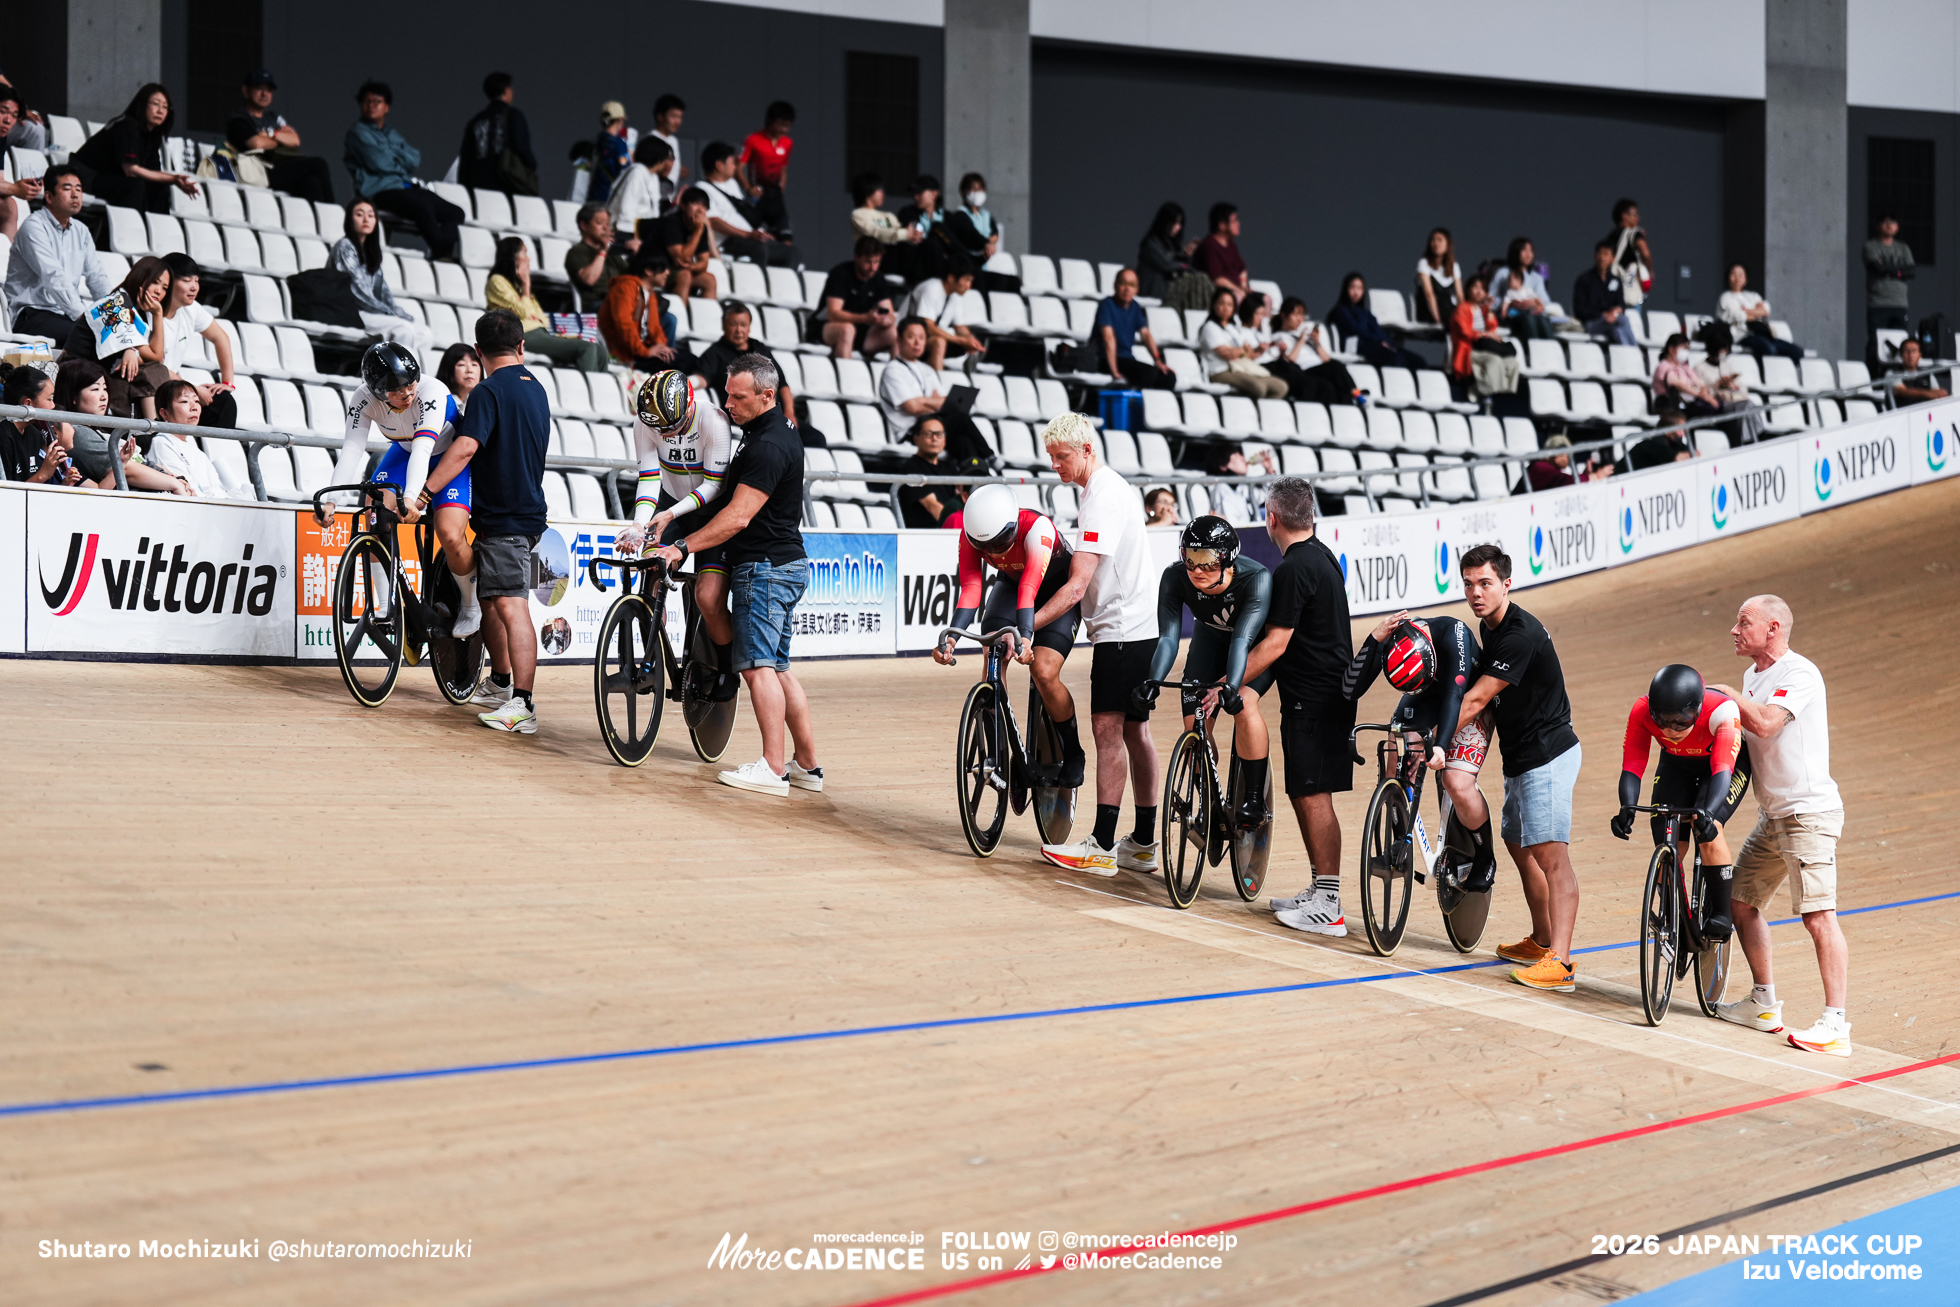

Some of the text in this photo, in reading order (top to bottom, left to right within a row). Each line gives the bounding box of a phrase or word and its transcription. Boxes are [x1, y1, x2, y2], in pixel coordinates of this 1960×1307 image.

[352, 399, 369, 430] TROXUS
[1837, 435, 1895, 486] NIPPO
[1638, 489, 1685, 538] NIPPO
[1733, 465, 1785, 514] NIPPO
[1548, 520, 1595, 570] NIPPO
[102, 537, 277, 616] vittoria
[844, 554, 861, 604] to
[862, 552, 885, 604] Ito
[1354, 553, 1408, 604] NIPPO
[1726, 768, 1748, 805] CHINA
